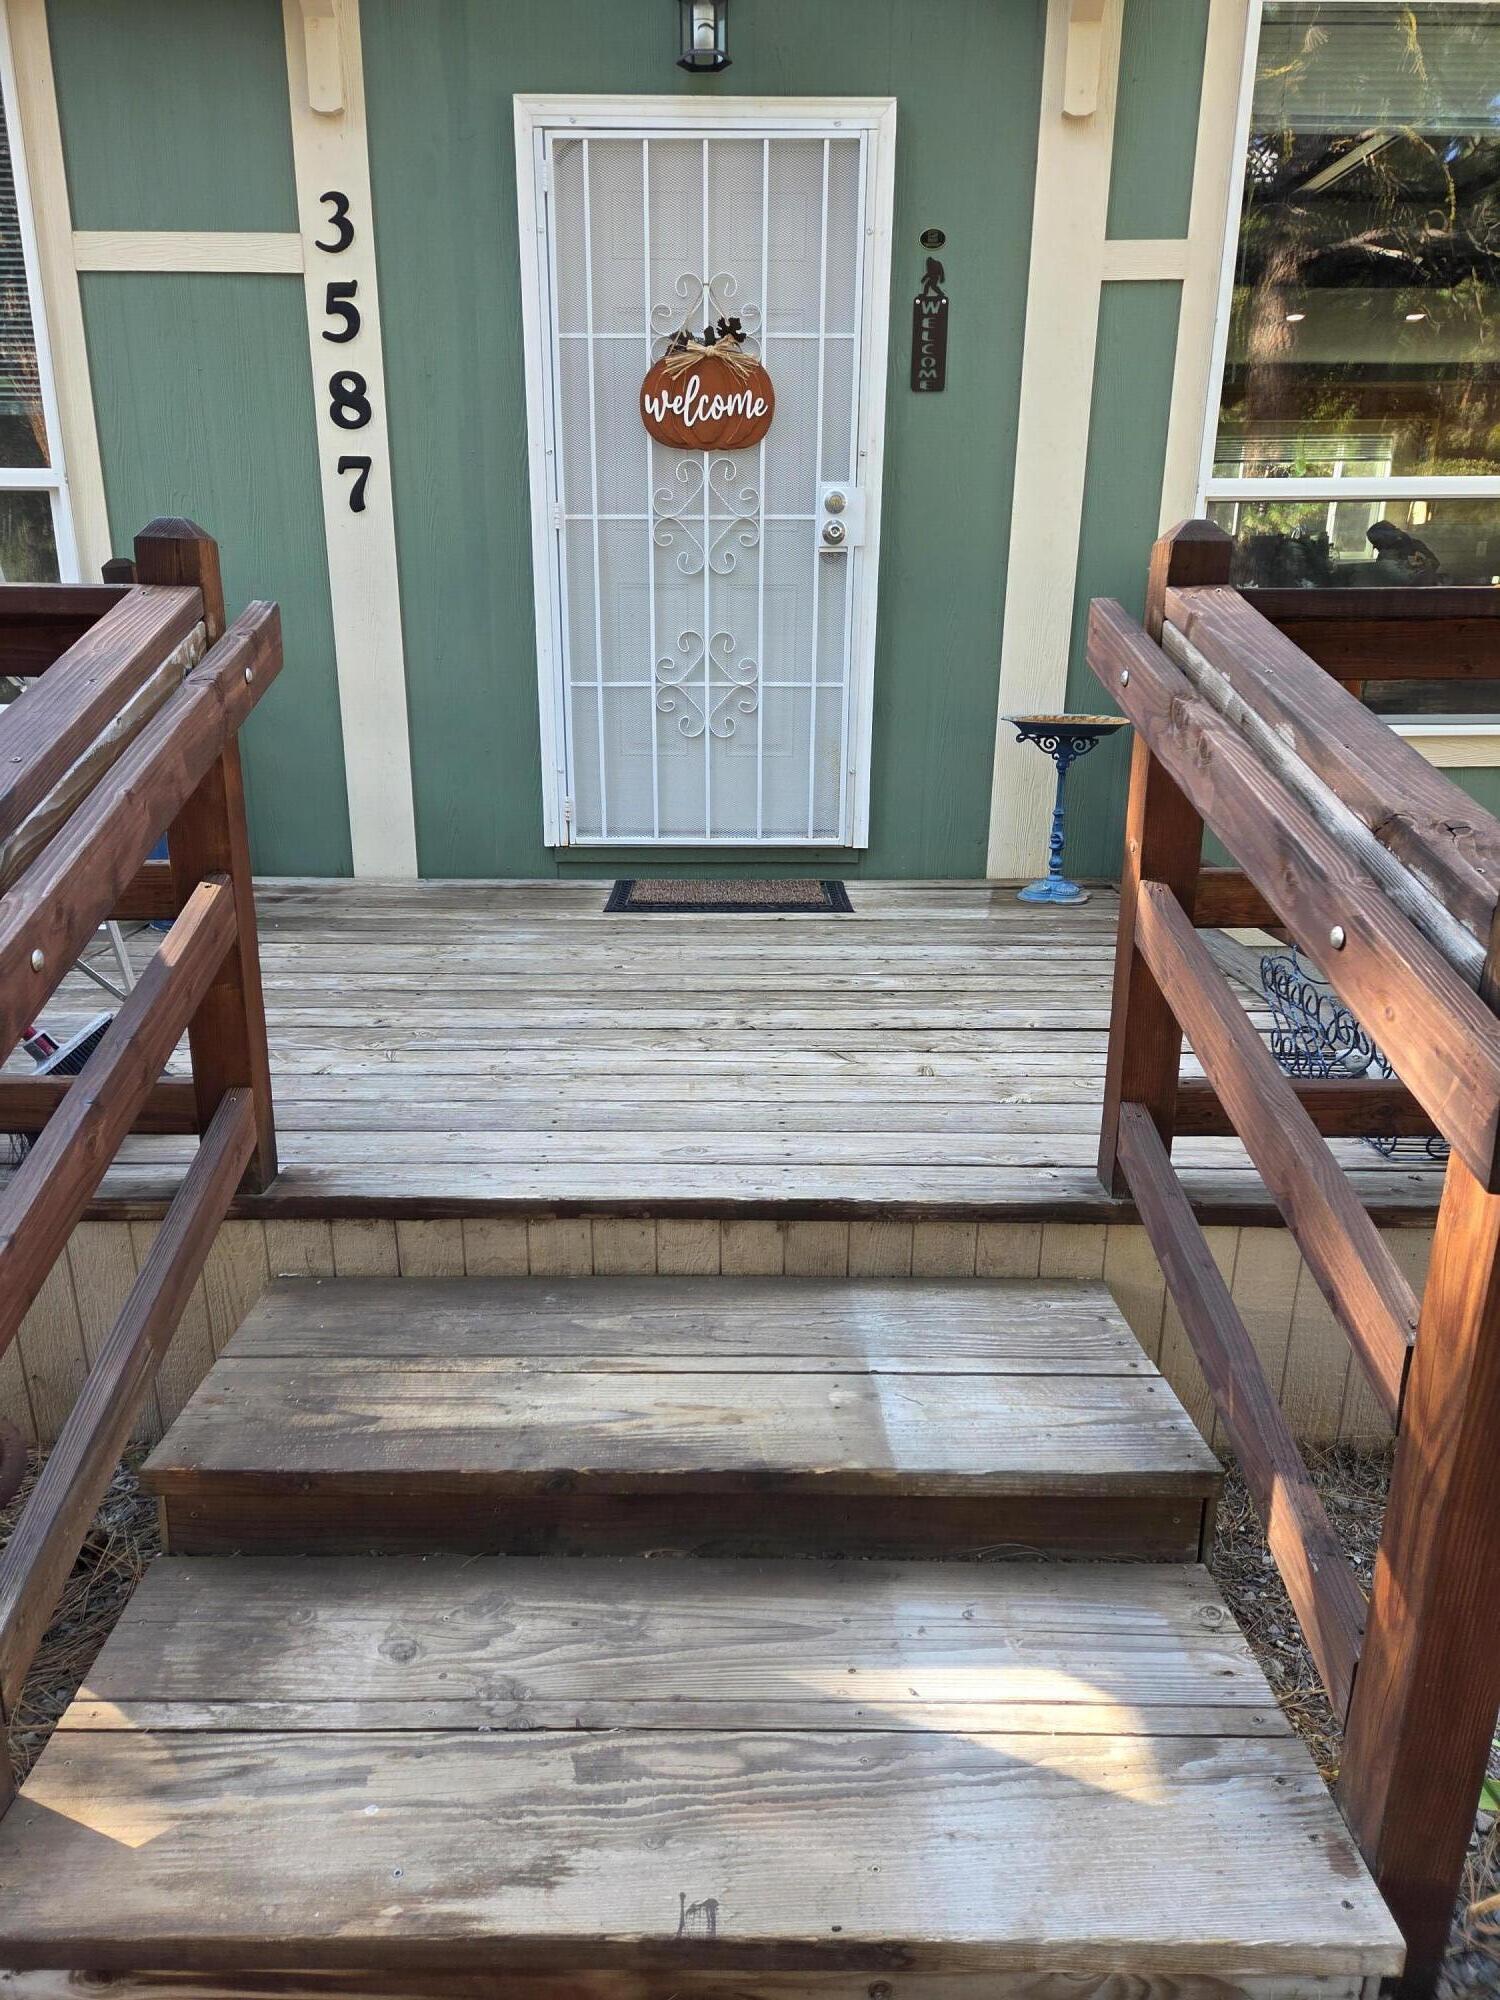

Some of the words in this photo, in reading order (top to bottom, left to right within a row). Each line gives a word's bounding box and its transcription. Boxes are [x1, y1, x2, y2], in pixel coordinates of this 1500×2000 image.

[315, 191, 372, 513] 3587
[918, 301, 941, 390] WELCOME
[644, 375, 768, 427] welcome
